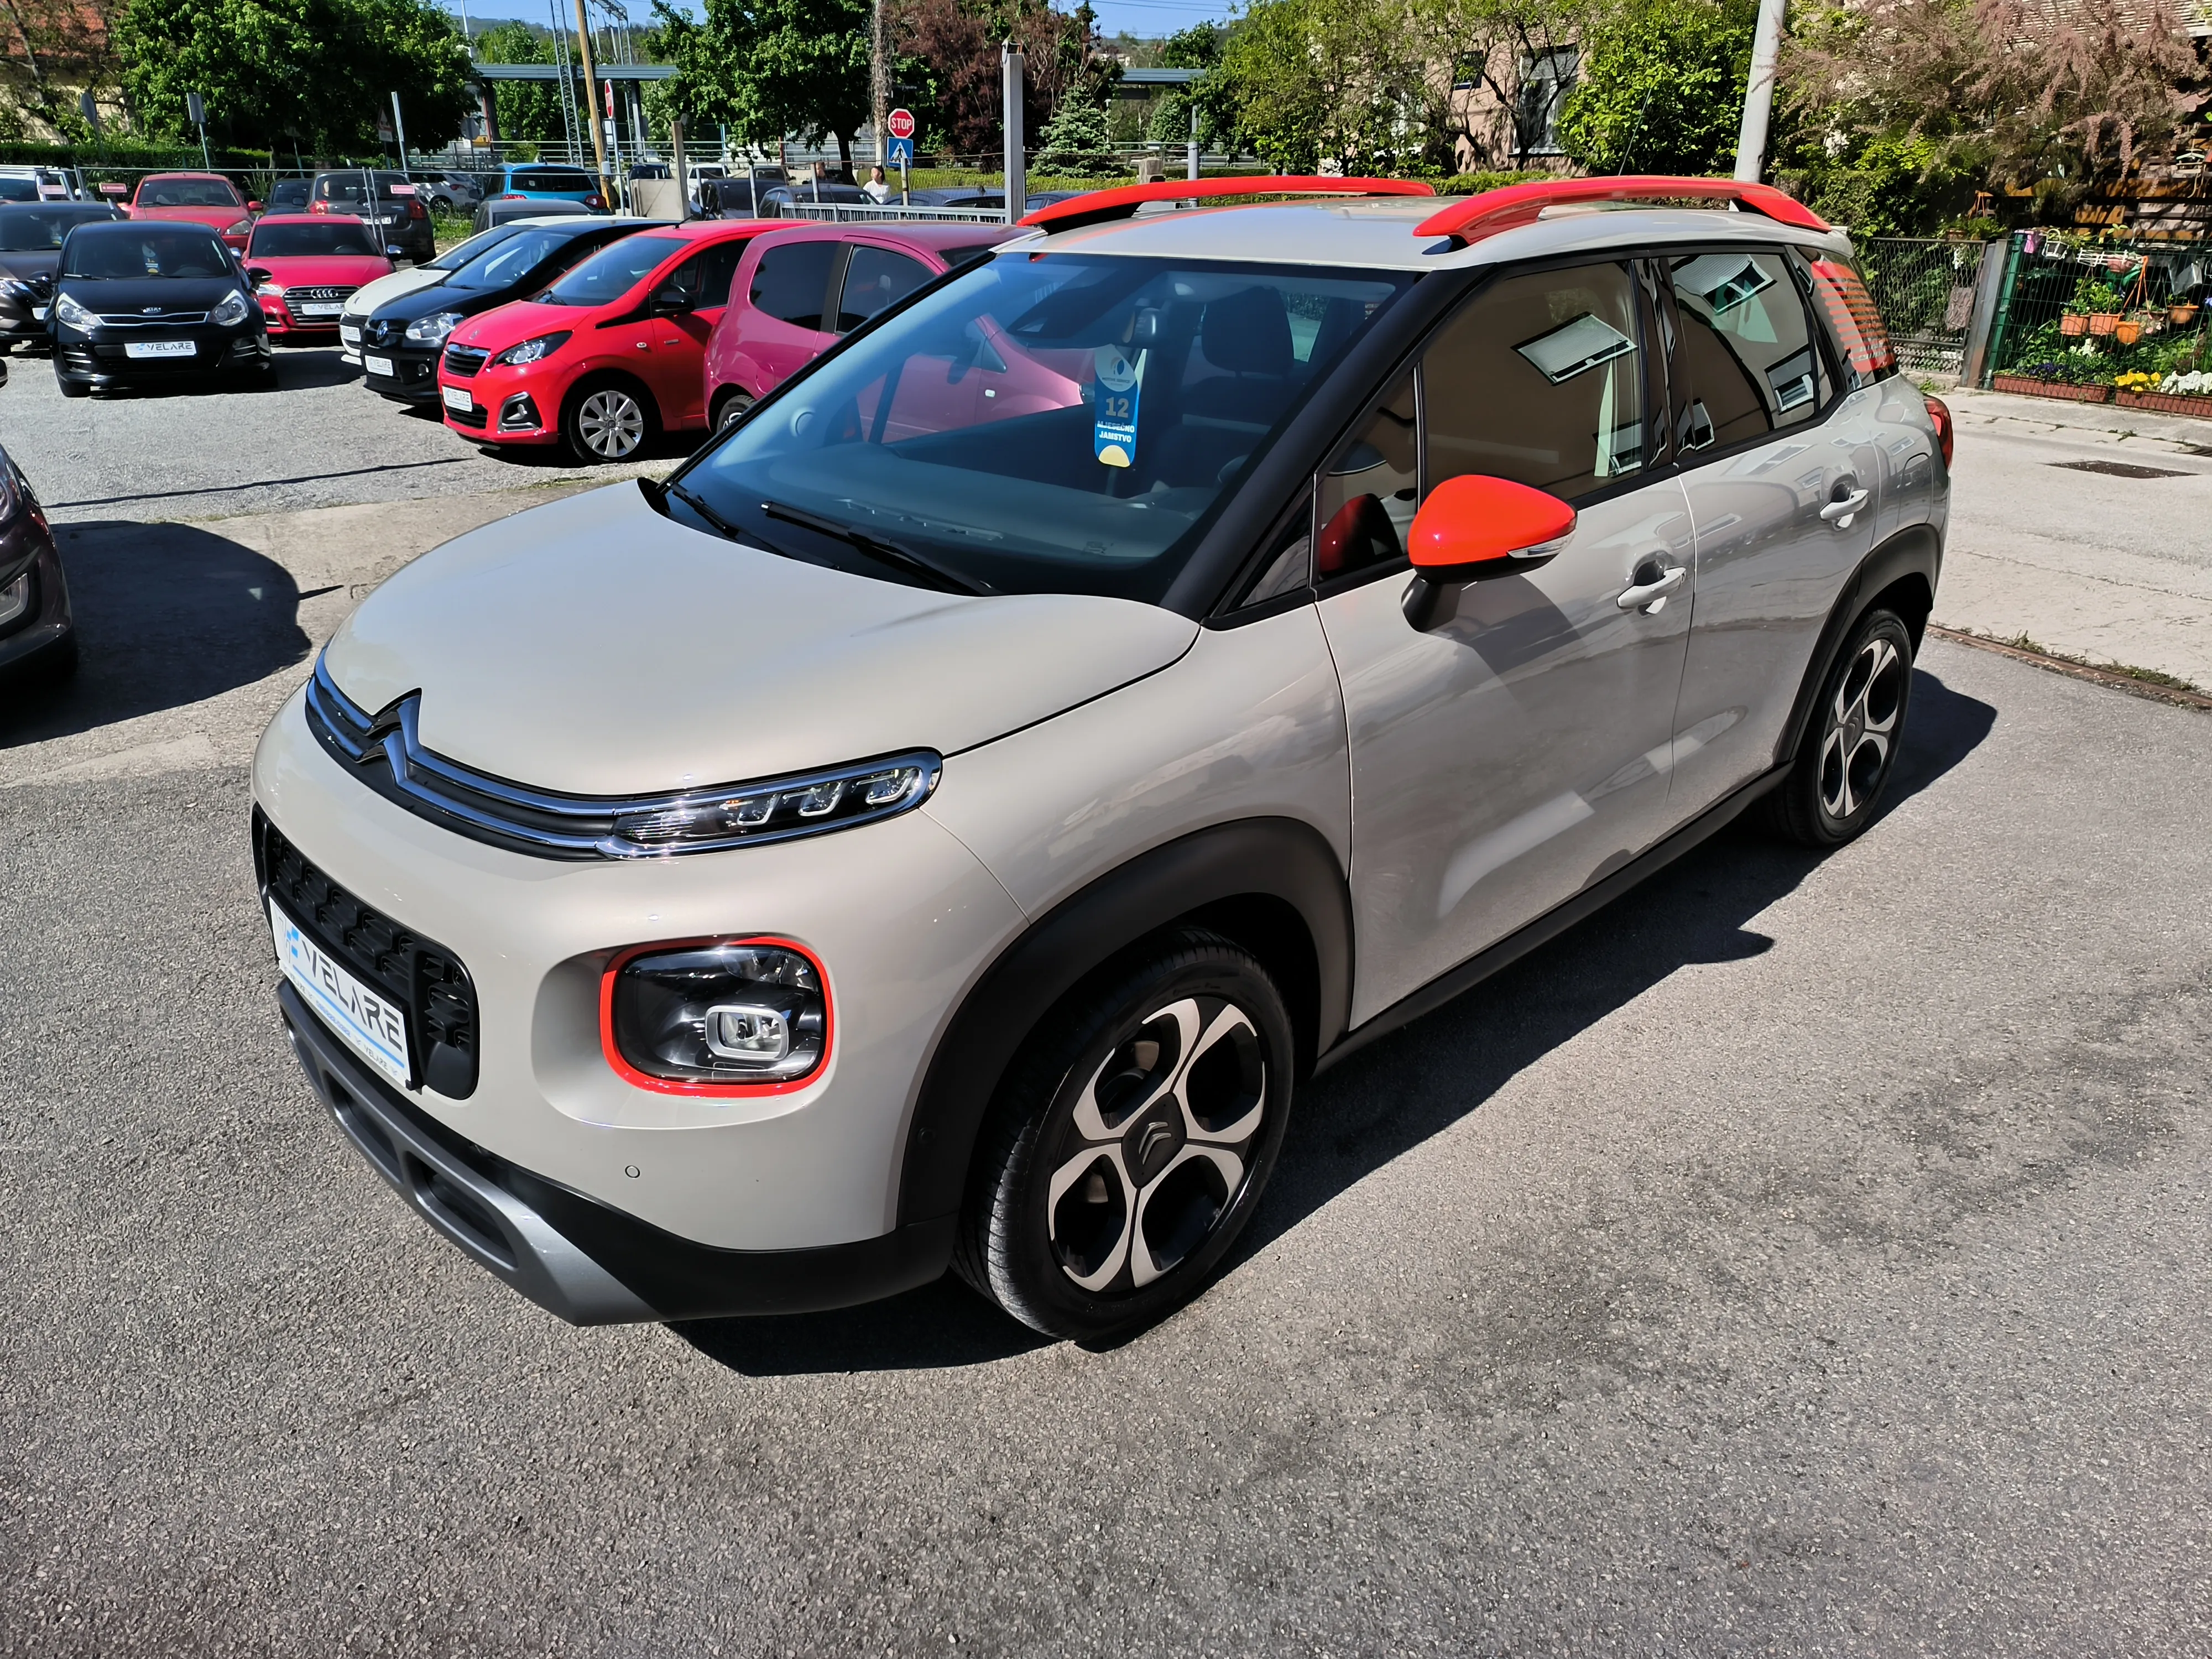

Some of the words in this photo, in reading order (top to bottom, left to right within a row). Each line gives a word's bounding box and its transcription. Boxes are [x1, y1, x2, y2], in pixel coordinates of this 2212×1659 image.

[891, 117, 912, 129] STOP
[1106, 397, 1129, 418] 12
[1097, 420, 1135, 432] MJESEČNO
[1099, 431, 1131, 442] JAMSTVO
[302, 940, 403, 1053] VELARE
[364, 1044, 388, 1071] VELARE
